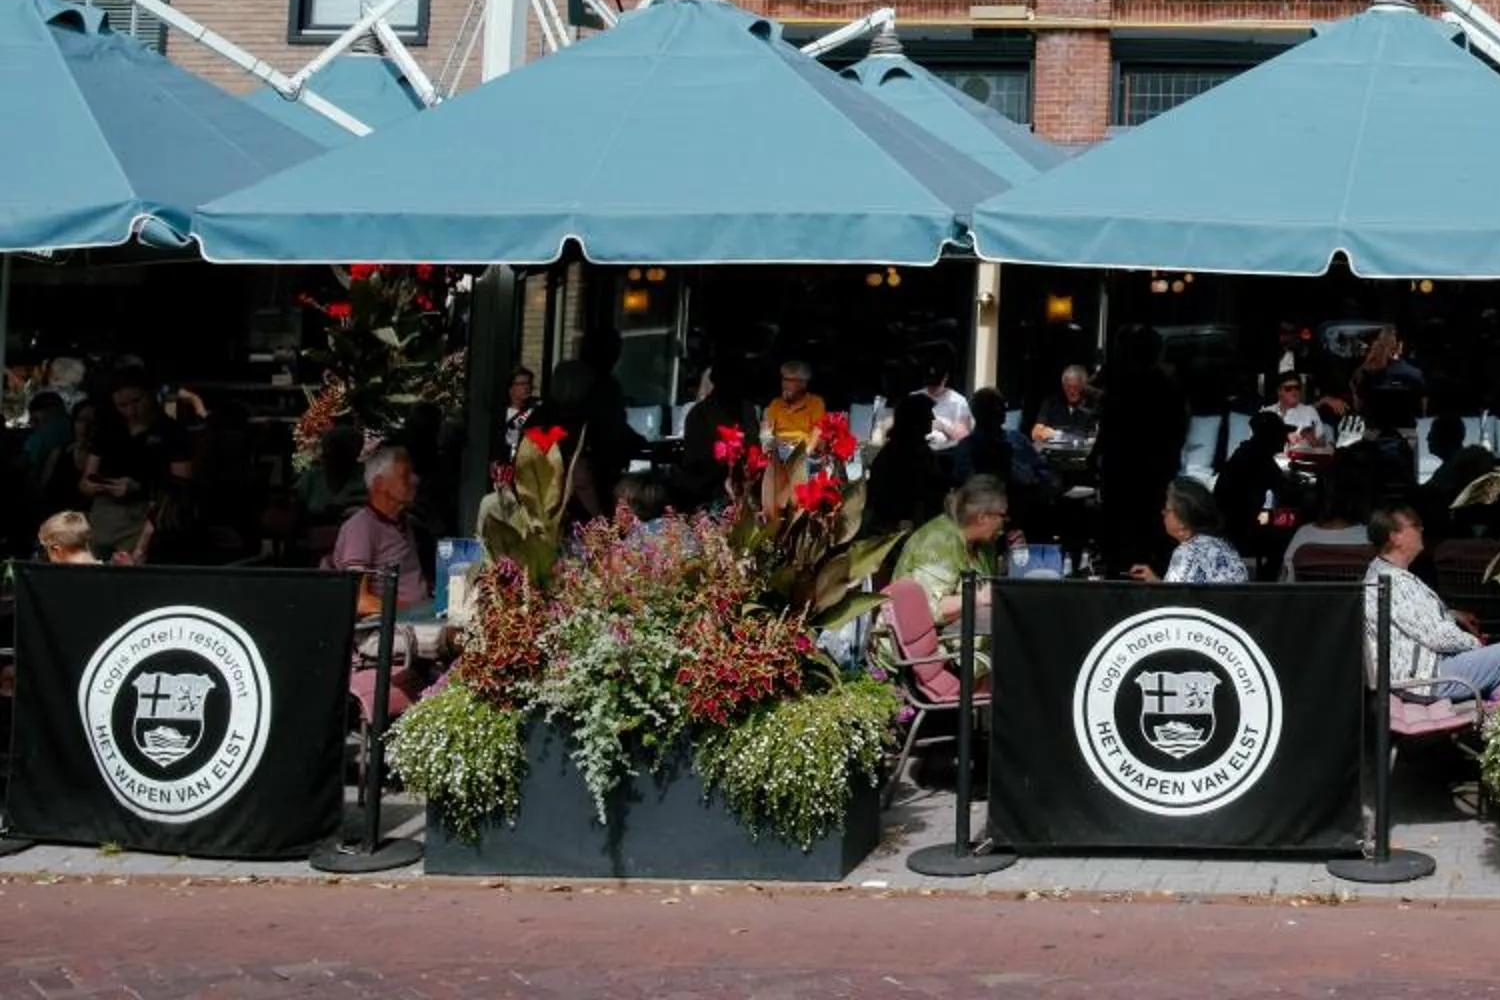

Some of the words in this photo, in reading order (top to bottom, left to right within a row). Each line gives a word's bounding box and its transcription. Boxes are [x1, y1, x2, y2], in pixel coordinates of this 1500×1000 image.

[99, 654, 129, 695] logis
[131, 627, 174, 657] hotel
[188, 630, 249, 699] restaurant
[1098, 654, 1127, 693] logis
[1127, 628, 1170, 655] hotel
[1186, 633, 1256, 695] restaurant
[95, 725, 117, 762] HET
[115, 764, 172, 804] WAPEN
[175, 777, 212, 803] VAN
[212, 730, 246, 779] ELST
[1096, 721, 1121, 760] HET
[1119, 760, 1185, 796] WAPEN
[1191, 768, 1229, 794] VAN
[1229, 724, 1259, 771] ELST
